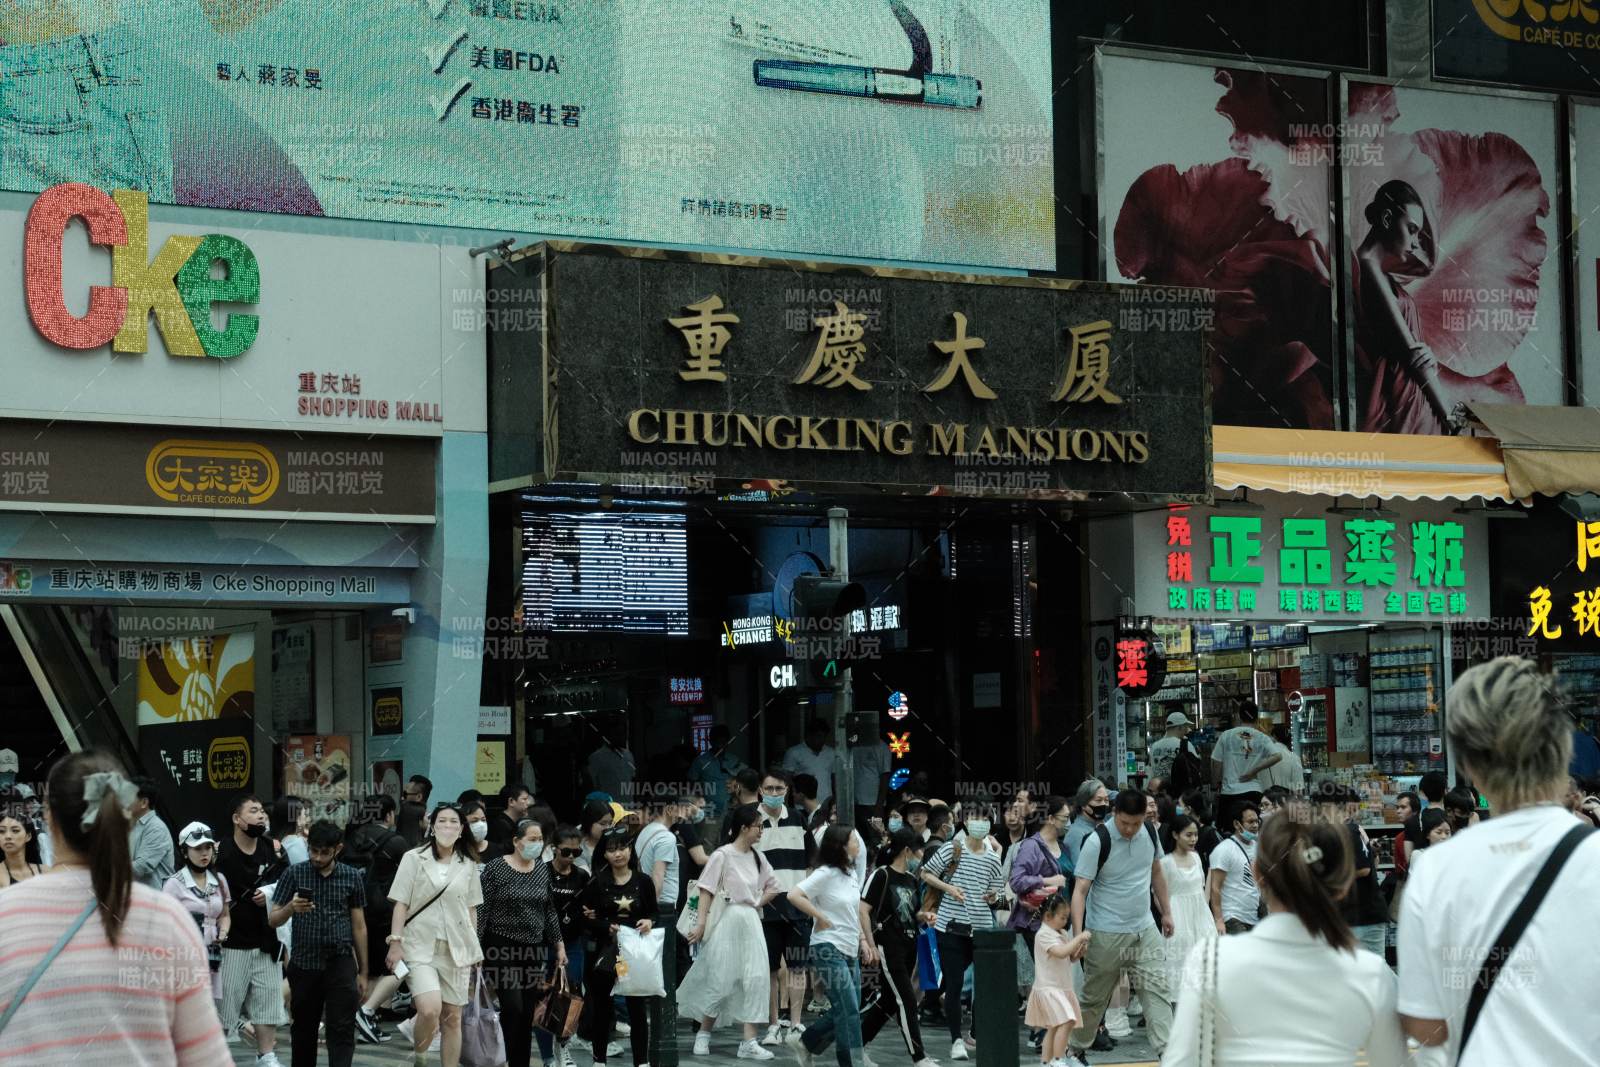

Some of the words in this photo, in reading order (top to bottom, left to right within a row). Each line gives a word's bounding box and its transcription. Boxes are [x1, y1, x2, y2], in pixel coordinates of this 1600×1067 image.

[1564, 32, 1582, 47] DE
[24, 182, 260, 358] Cke
[298, 372, 361, 394] 重庆站
[298, 397, 390, 419] SHOPPING
[396, 400, 443, 422] MALL
[627, 408, 913, 456] CHUNGKING
[928, 422, 1151, 464] MANSIONS
[218, 496, 247, 505] CORAL
[1167, 503, 1192, 582] 免税
[51, 569, 202, 591] 重庆站購物商場
[213, 575, 247, 591] Cke
[253, 575, 335, 596] Shopping
[341, 577, 375, 593] Mall
[1168, 587, 1256, 610] 政府註冊
[1384, 591, 1466, 613] 全國包郵
[733, 617, 751, 629] HONG
[752, 616, 770, 627] KONG
[721, 629, 771, 649] EXCHANGE
